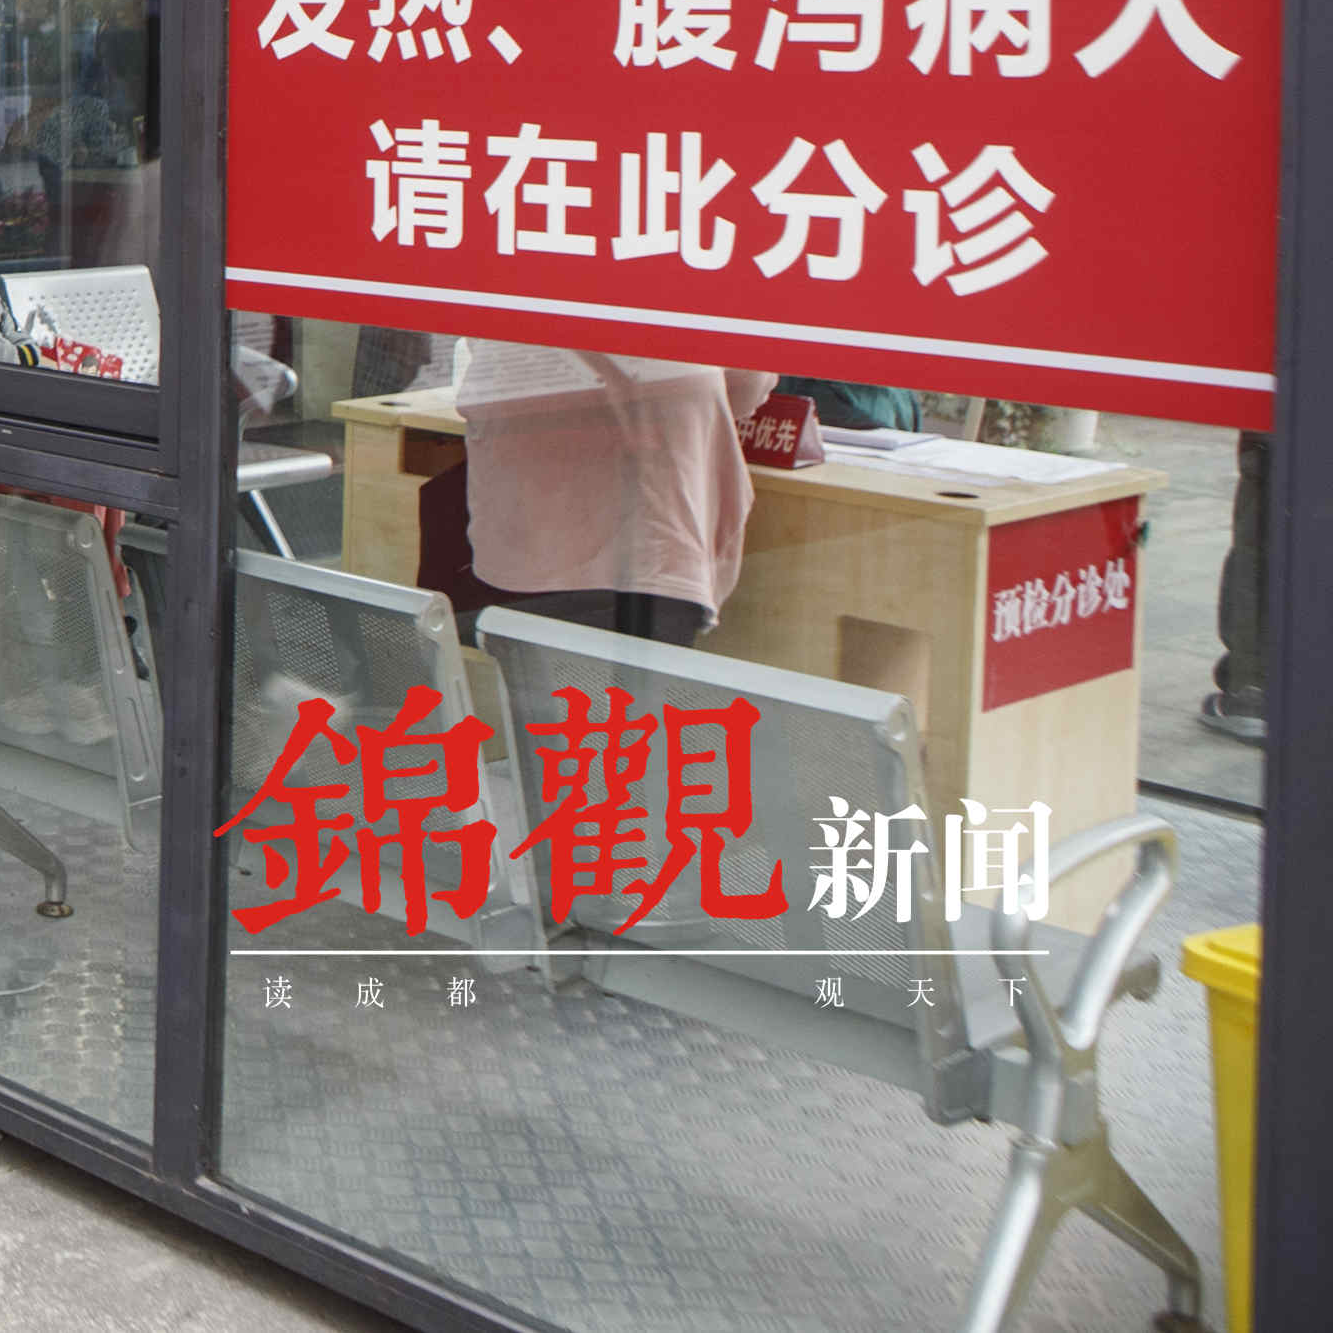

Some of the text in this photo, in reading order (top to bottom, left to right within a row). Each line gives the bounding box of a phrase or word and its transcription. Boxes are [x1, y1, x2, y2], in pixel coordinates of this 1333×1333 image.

[365, 120, 1055, 296] 请在此分诊
[992, 557, 1130, 642] 预检分诊处
